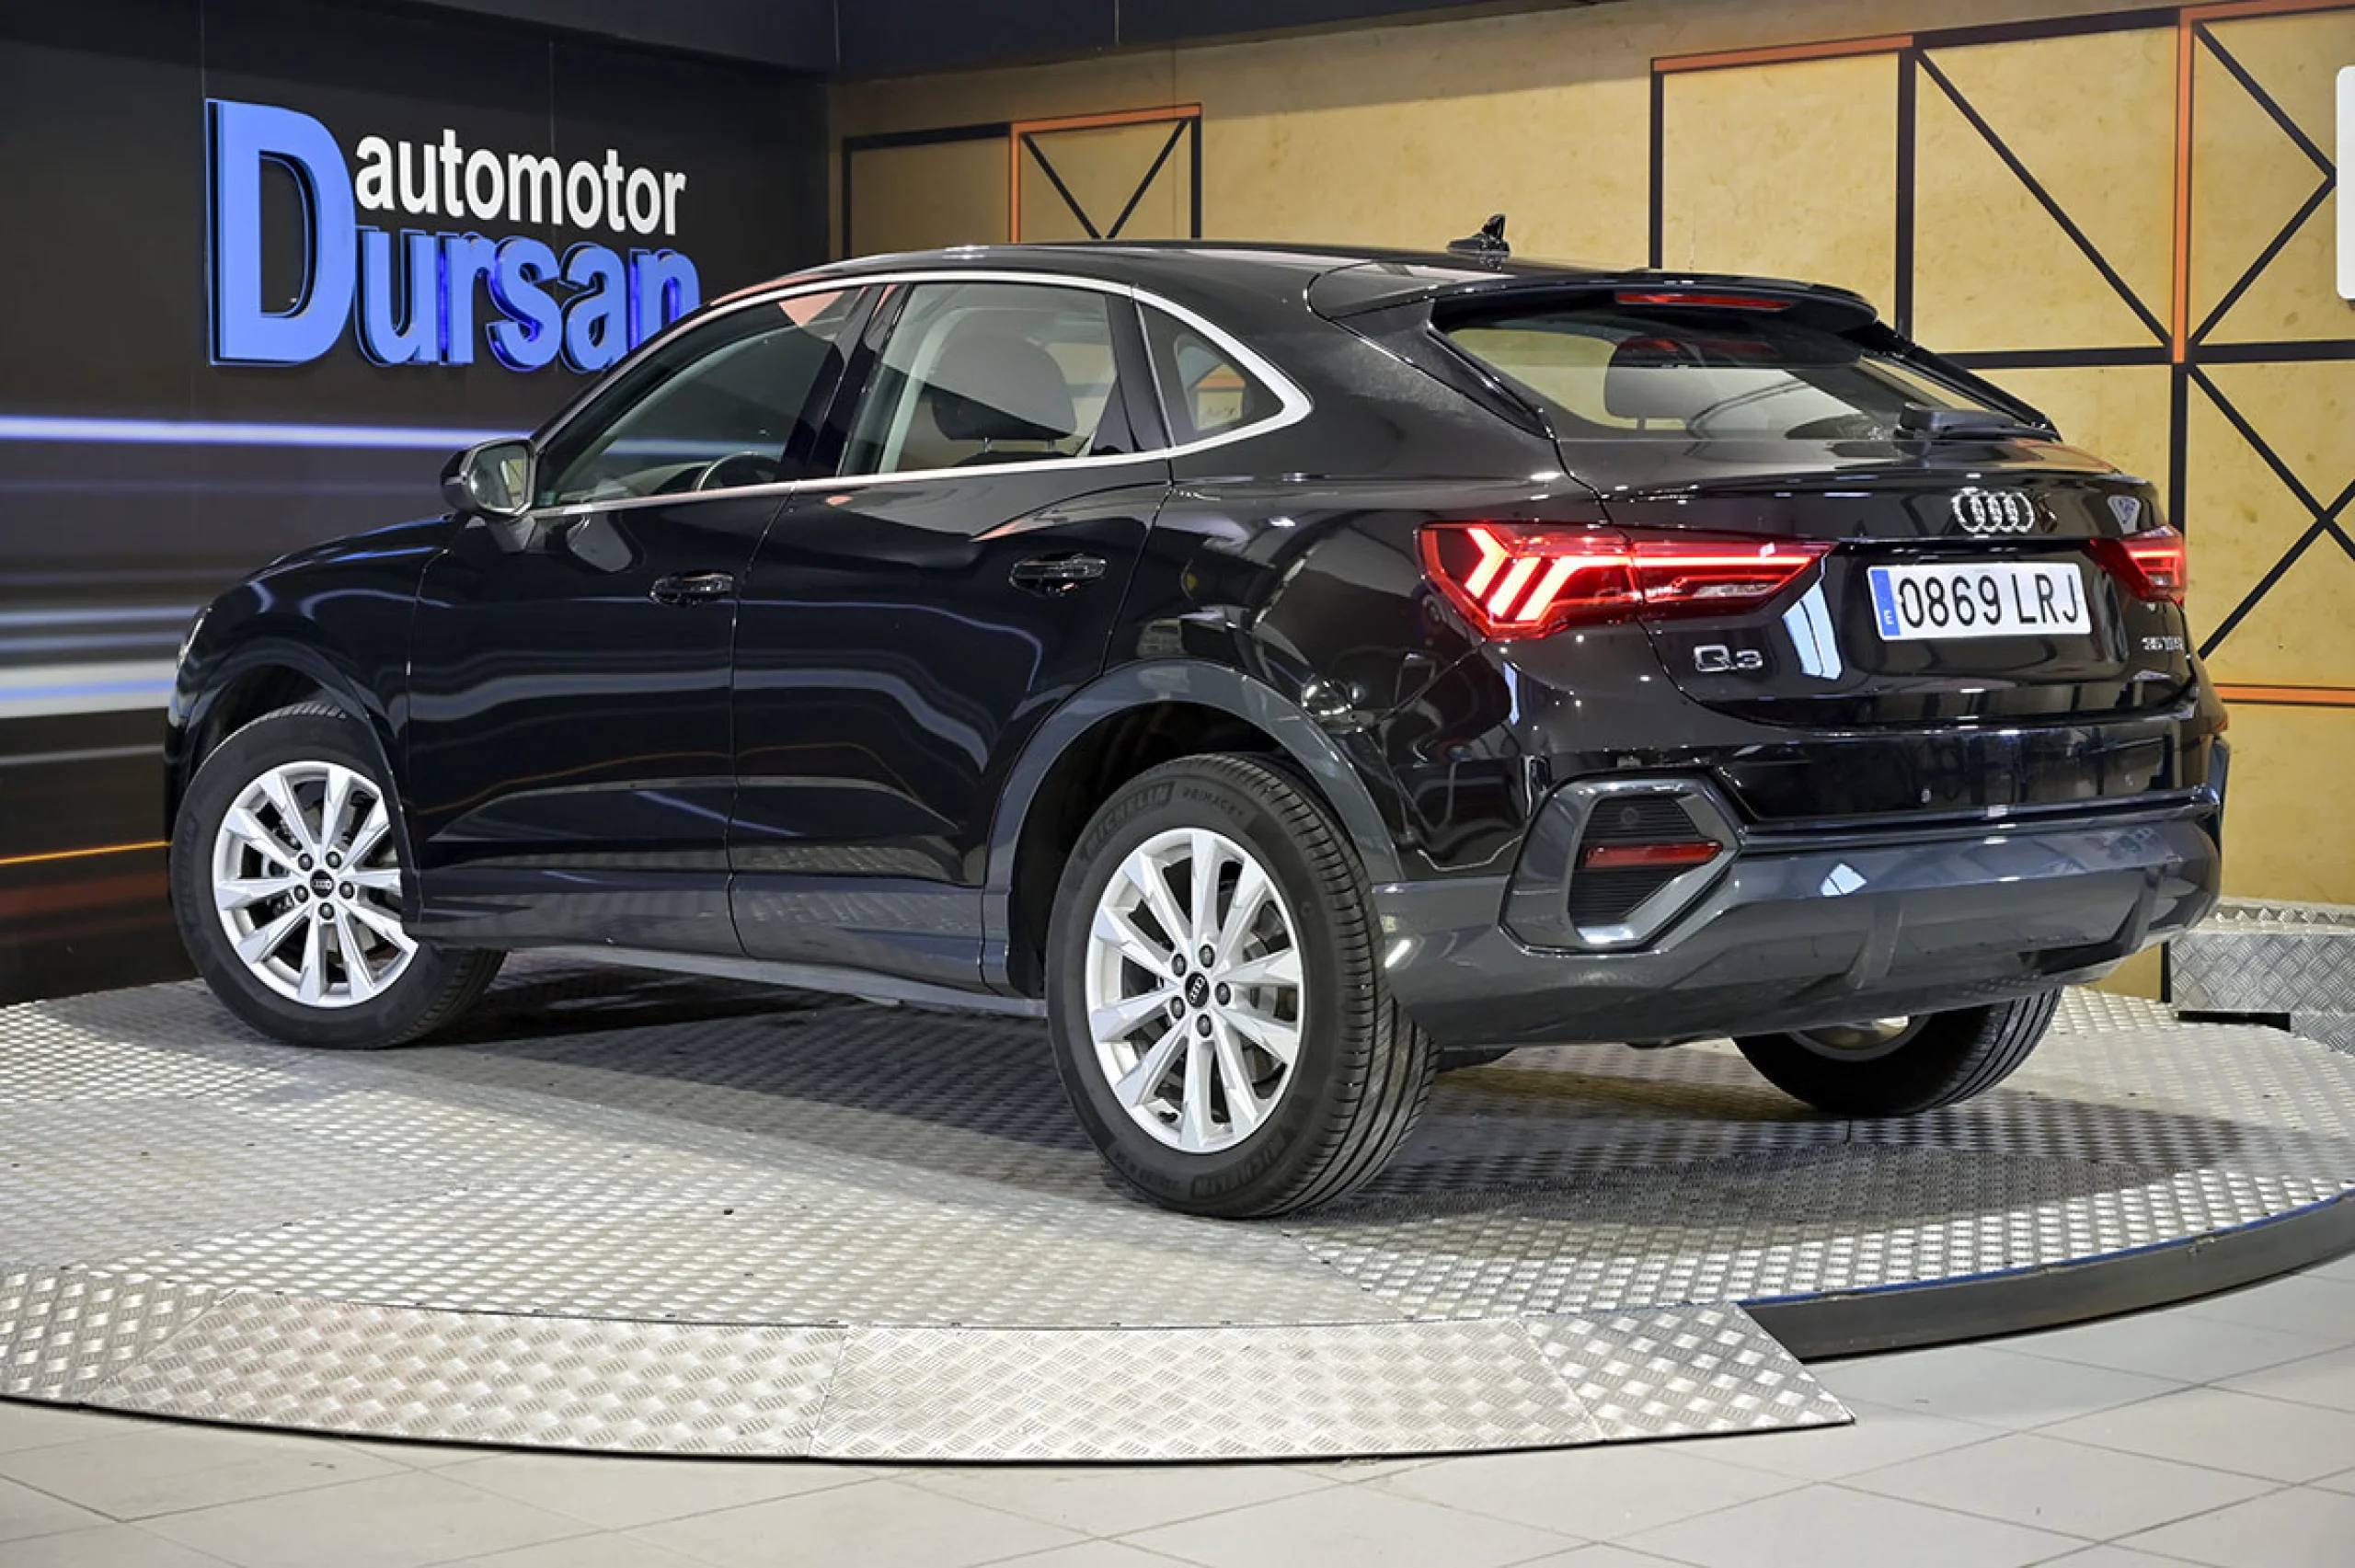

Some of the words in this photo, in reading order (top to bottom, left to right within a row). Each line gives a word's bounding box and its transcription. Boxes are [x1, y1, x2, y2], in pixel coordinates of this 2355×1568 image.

[355, 128, 686, 235] automotor
[205, 97, 700, 374] Dursan
[1883, 609, 1894, 625] E
[1898, 574, 2003, 629] 0869
[2011, 572, 2079, 624] LRJ
[1694, 645, 1763, 672] Q3
